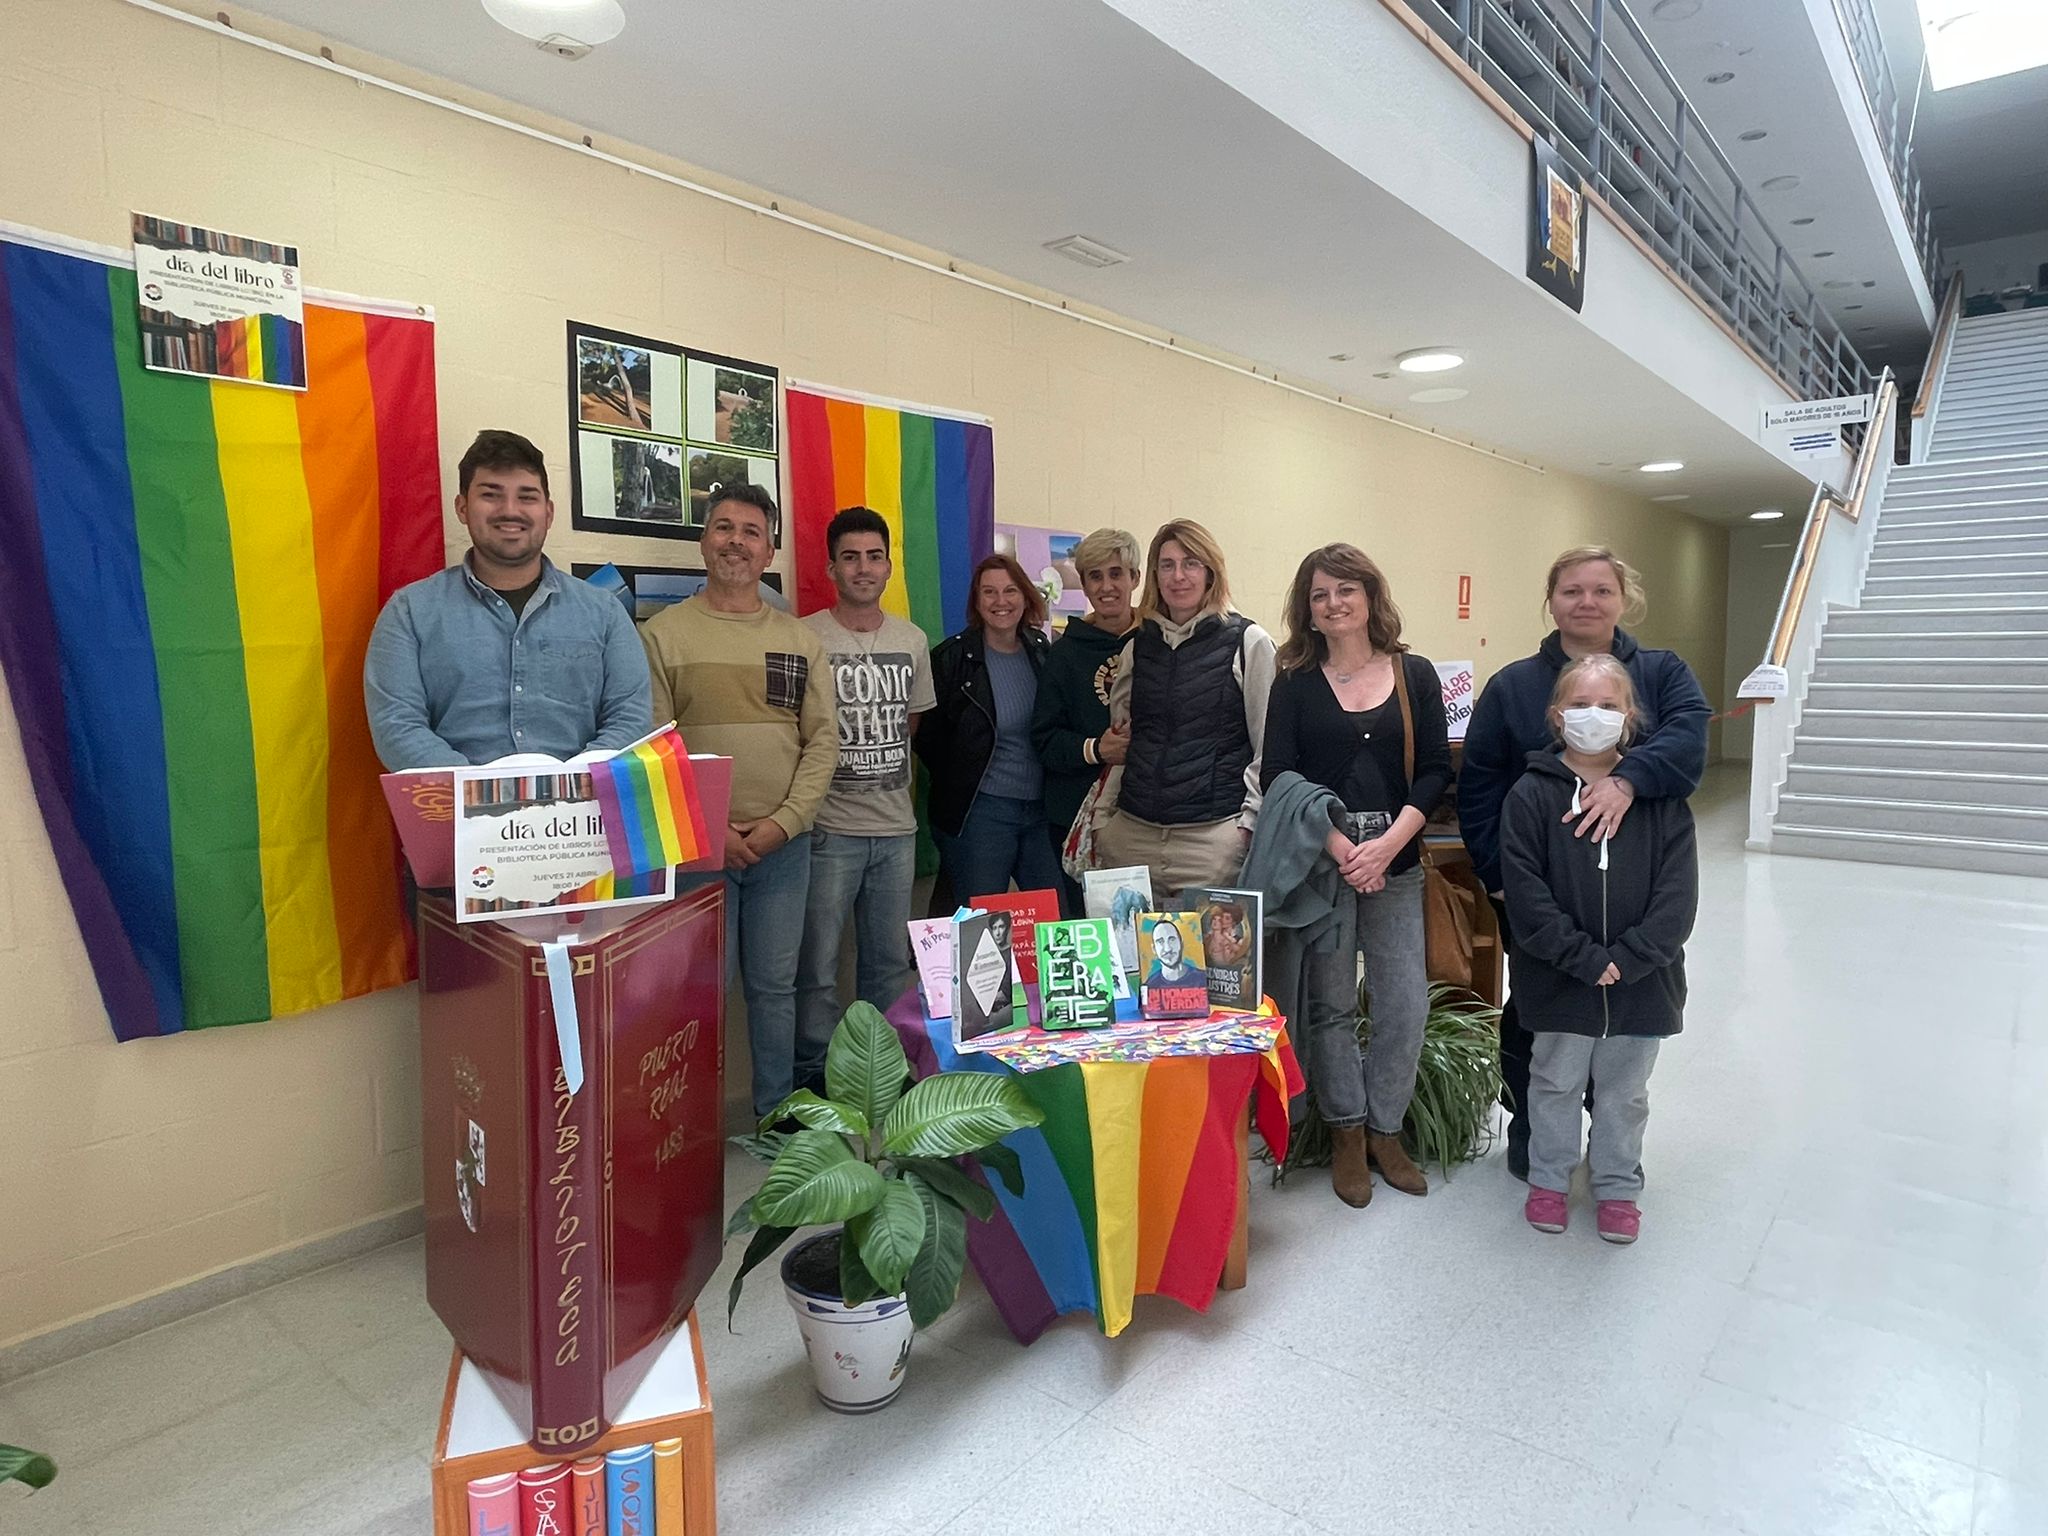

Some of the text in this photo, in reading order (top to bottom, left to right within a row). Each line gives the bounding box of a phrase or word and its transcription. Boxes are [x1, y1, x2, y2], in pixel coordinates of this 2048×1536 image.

[202, 261, 227, 280] del
[234, 266, 274, 289] libro
[1784, 409, 1803, 417] SALA
[1814, 404, 1847, 413] ADULTOS
[1789, 413, 1822, 423] MAYORES
[1449, 670, 1473, 688] DEL
[839, 751, 881, 767] QUALITY
[501, 819, 536, 841] día
[544, 815, 578, 837] del
[480, 843, 547, 854] PRESENTACIÓN
[548, 842, 560, 850] DE
[561, 841, 592, 849] LIBROS
[497, 854, 548, 864] BIBLIOTECA
[550, 850, 586, 860] PÚBLICA
[532, 869, 599, 882] JUEVES 21 ABRIL
[1161, 987, 1206, 999] HOMBRE
[1163, 997, 1207, 1010] VERDAD
[639, 1019, 699, 1087] PUERTO
[650, 1062, 688, 1121] REAL
[550, 1066, 586, 1367] BIBLIOTECA
